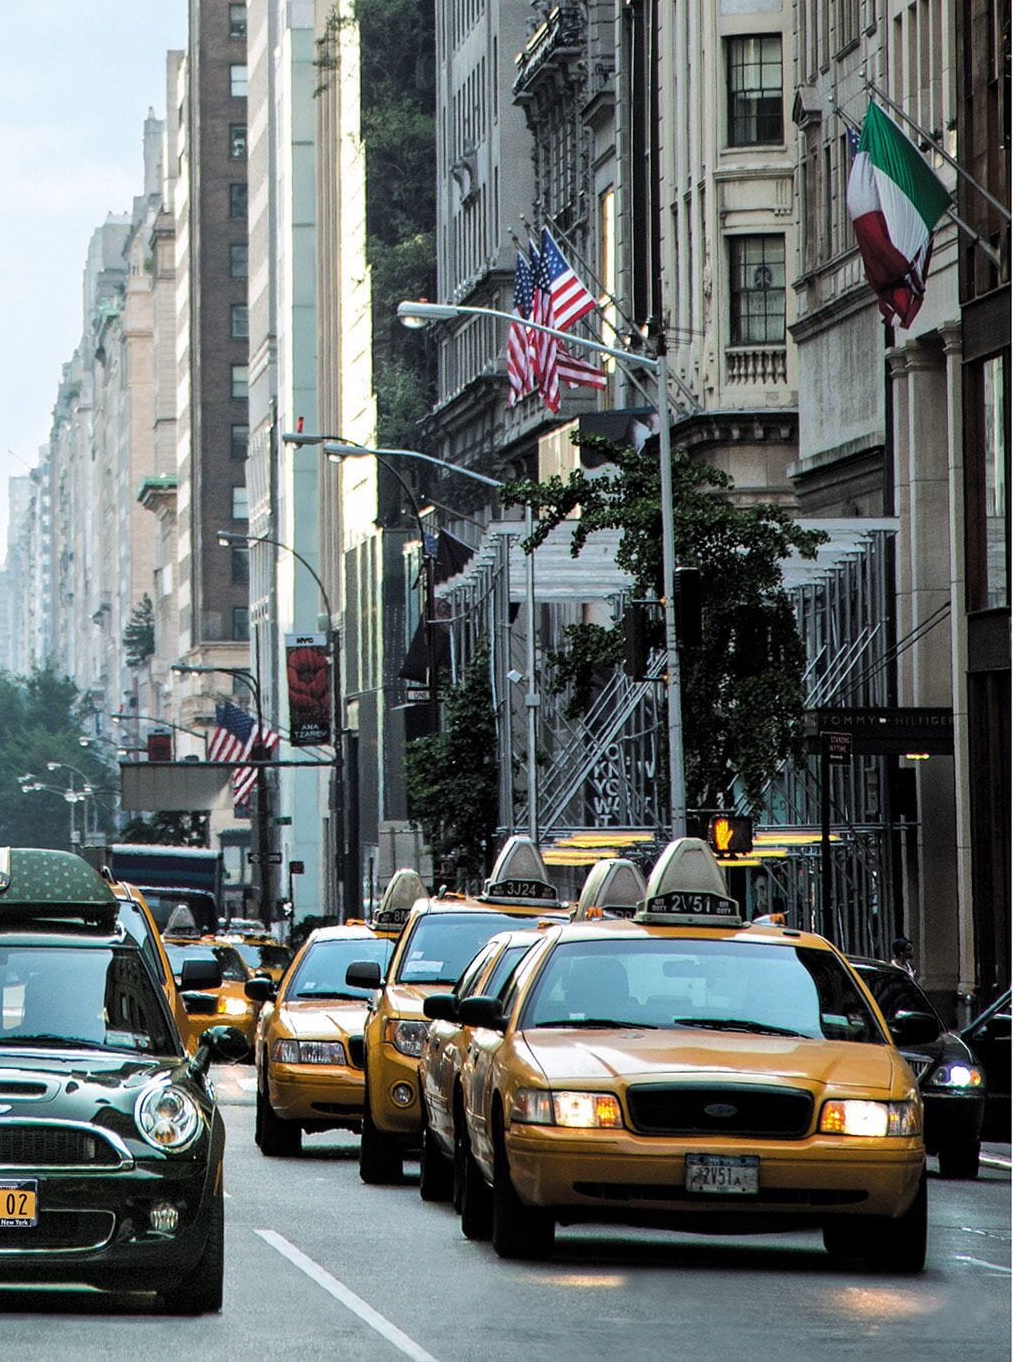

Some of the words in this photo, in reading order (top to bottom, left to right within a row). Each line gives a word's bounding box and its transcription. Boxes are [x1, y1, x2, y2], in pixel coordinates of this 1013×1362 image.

[822, 716, 875, 725] TOMMY
[507, 882, 536, 896] 3J24
[671, 895, 710, 912] 2V51
[6, 1193, 28, 1215] 02
